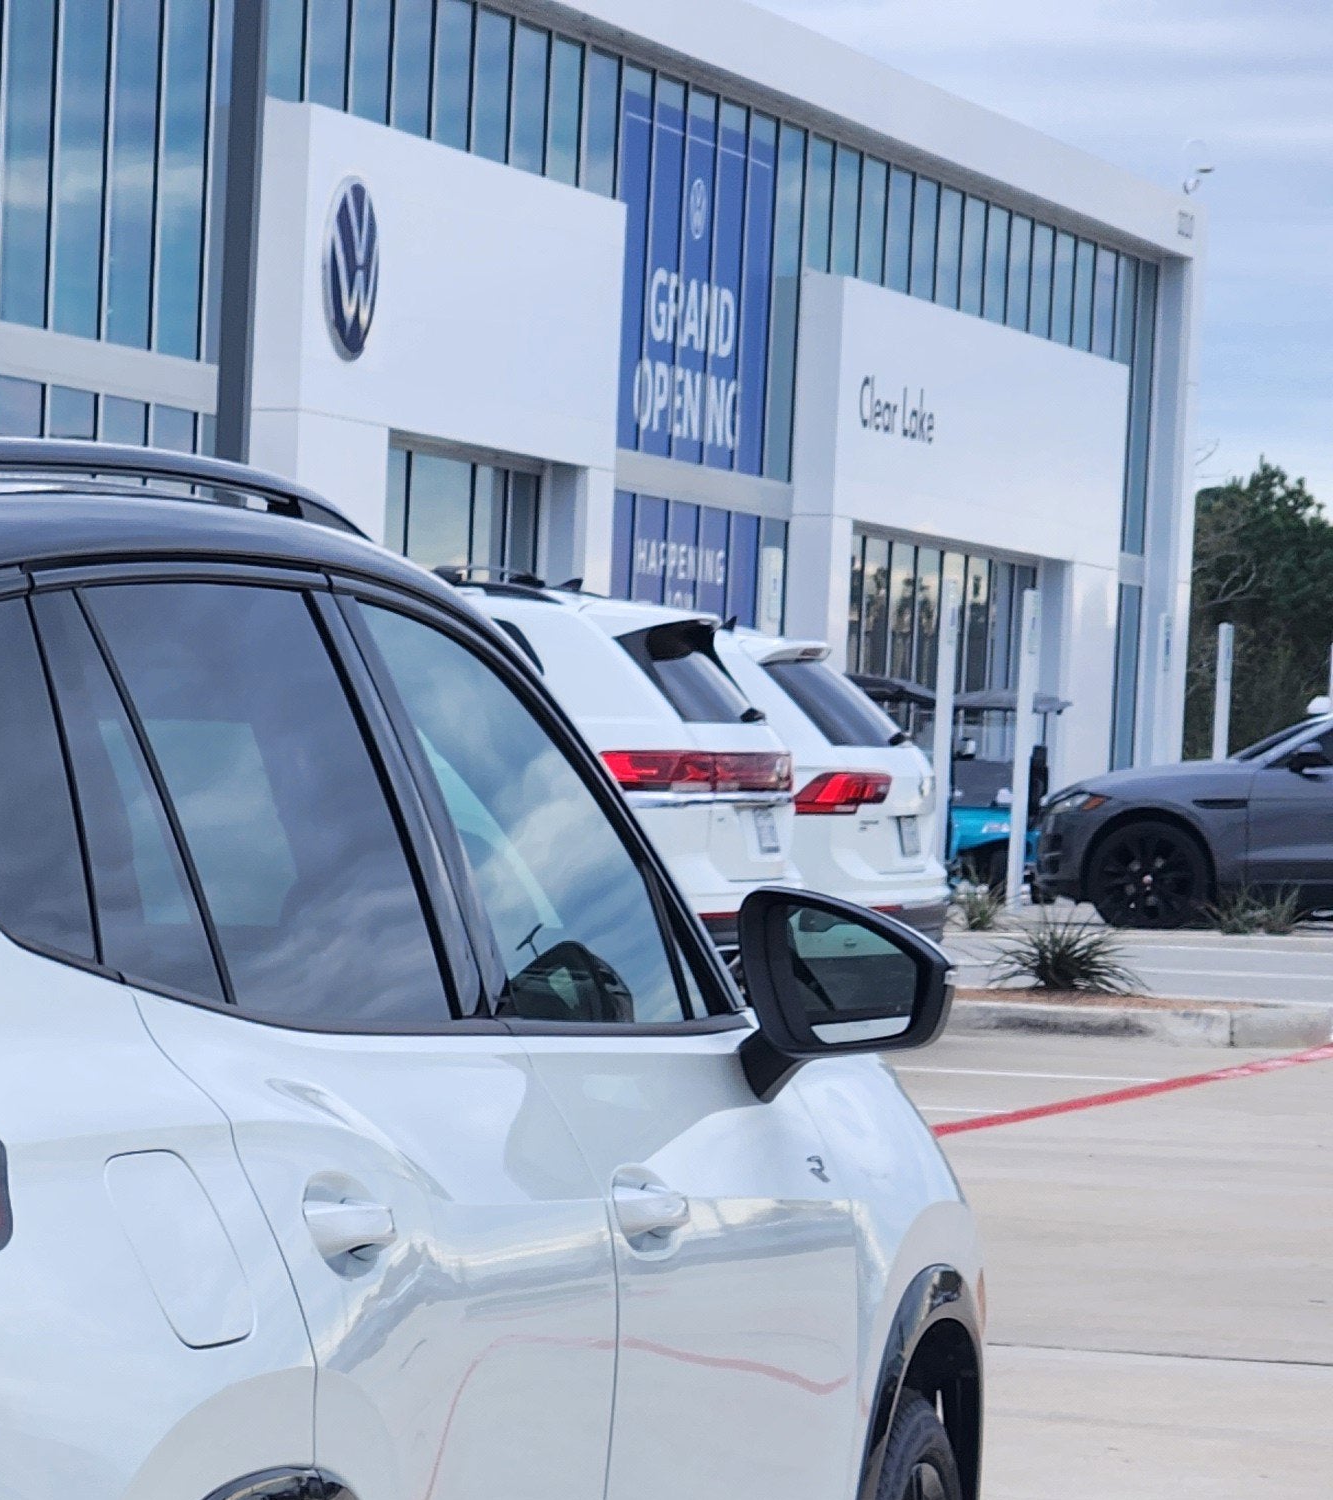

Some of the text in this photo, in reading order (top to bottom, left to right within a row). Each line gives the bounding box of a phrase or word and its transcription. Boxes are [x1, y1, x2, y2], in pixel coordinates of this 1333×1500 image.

[650, 267, 735, 358] GRAND
[634, 356, 741, 450] OPENING
[859, 374, 934, 444] Clear Lake
[635, 538, 726, 587] HAPPENING
